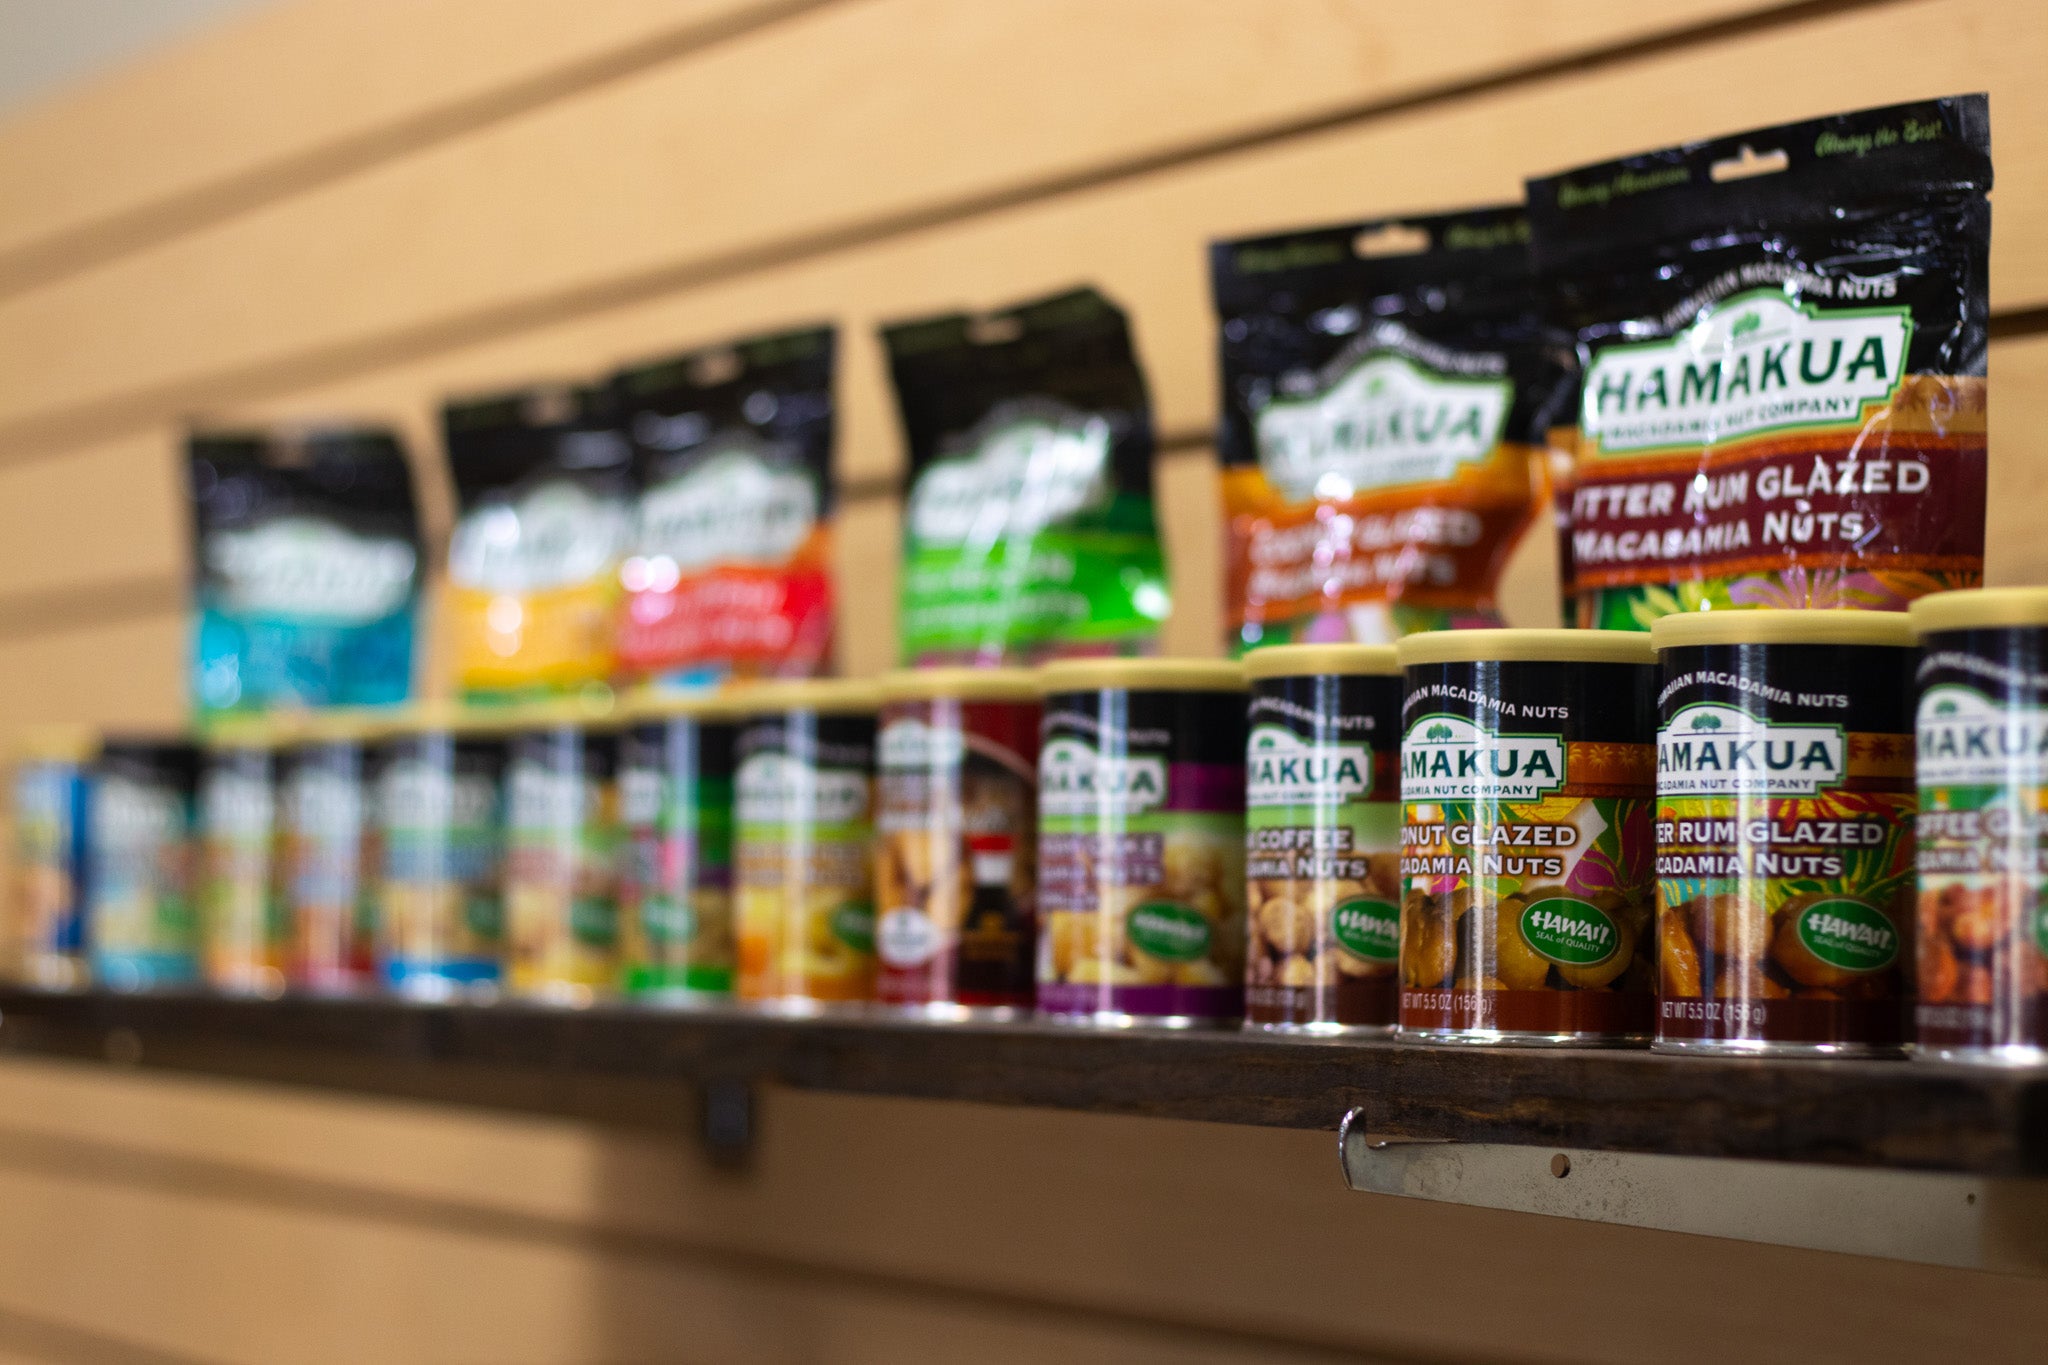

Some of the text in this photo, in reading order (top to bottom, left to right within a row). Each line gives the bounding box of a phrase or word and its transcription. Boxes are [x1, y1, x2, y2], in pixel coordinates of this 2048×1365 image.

[1838, 278, 1898, 301] NUTS
[1598, 335, 1889, 417] HAMAKUA
[1758, 395, 1855, 424] COMPANY
[1683, 470, 1749, 515] RUM
[1755, 459, 1932, 501] GLAZED
[1572, 510, 1866, 564] MACADAMIA NUTS
[1695, 669, 1793, 705] MACADAMIA
[1796, 693, 1849, 709] NUTS
[1431, 683, 1516, 717] MACADAMIA
[1522, 706, 1569, 719] NUTS
[1400, 749, 1557, 779] AMAKUA
[1656, 740, 1835, 773] AMAKUA
[1400, 784, 1534, 796] DAMIA NUT COMPANY
[1700, 778, 1728, 790] NUT
[1732, 778, 1811, 790] COMPANY
[1257, 828, 1351, 850] COFFEE
[1450, 824, 1578, 847] GLAZED
[1679, 822, 1737, 844] RUM
[1745, 822, 1884, 845] GLAZED
[1297, 857, 1367, 879] NUTS
[1482, 854, 1563, 876] NUTS
[1755, 852, 1842, 876] NUTS
[1535, 930, 1601, 953] SEAL of QUALITY
[1423, 992, 1437, 1010] 5.5
[1438, 993, 1453, 1010] OZ
[1688, 1002, 1704, 1020] 5.5
[1705, 1002, 1721, 1020] OZ
